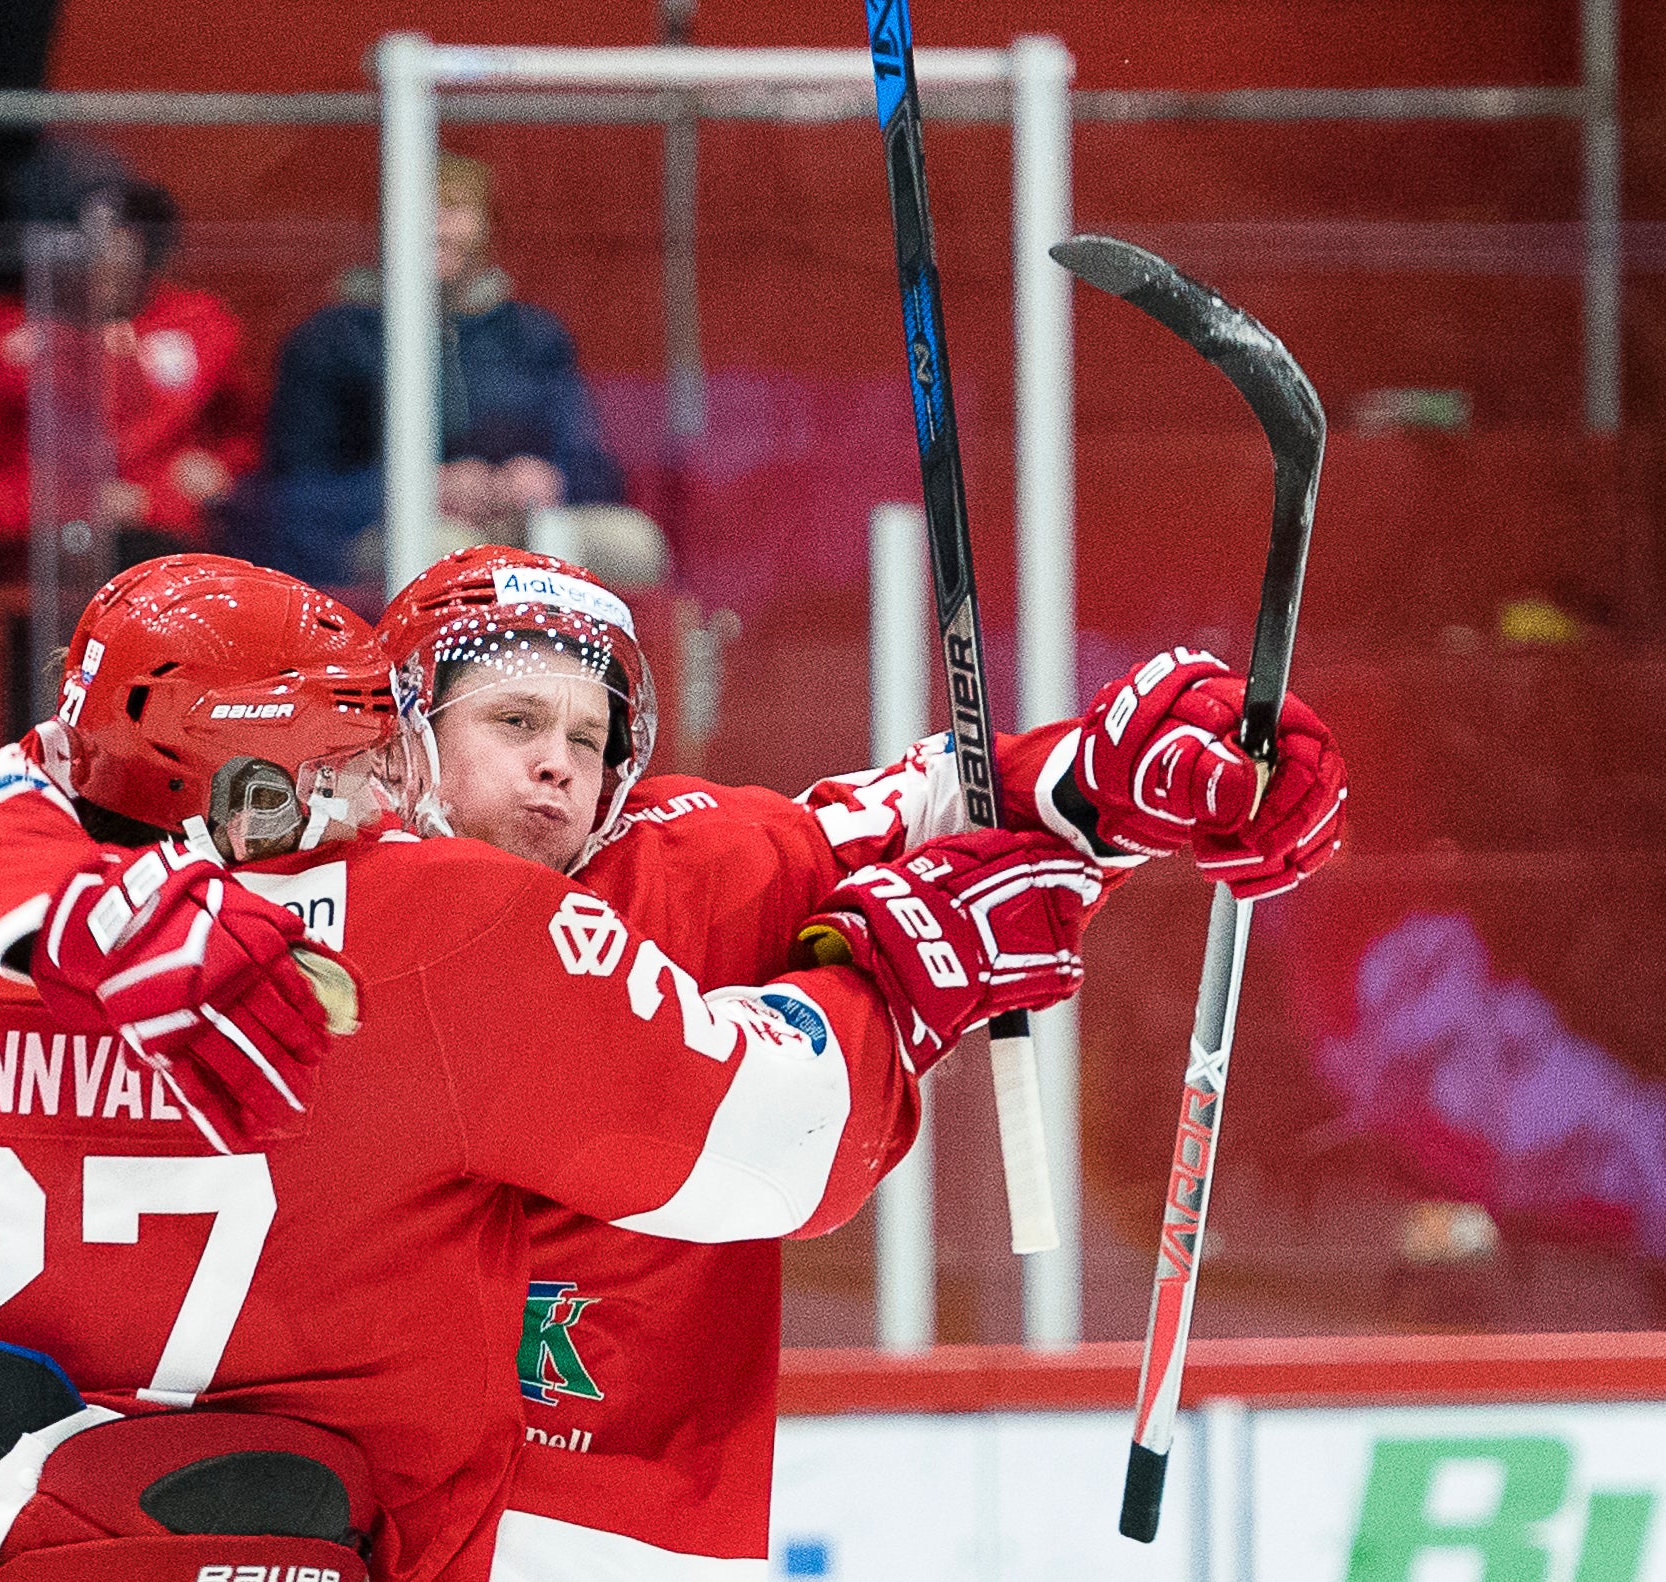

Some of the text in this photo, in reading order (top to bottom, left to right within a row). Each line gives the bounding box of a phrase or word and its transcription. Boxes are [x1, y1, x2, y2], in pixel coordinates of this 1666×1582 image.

[211, 703, 295, 720] BAUER
[947, 633, 996, 828] BAUER
[1104, 646, 1230, 746] BAU
[284, 896, 335, 930] on
[836, 865, 969, 988] BAU
[1157, 1084, 1217, 1285] VAPOR
[516, 1278, 605, 1407] K
